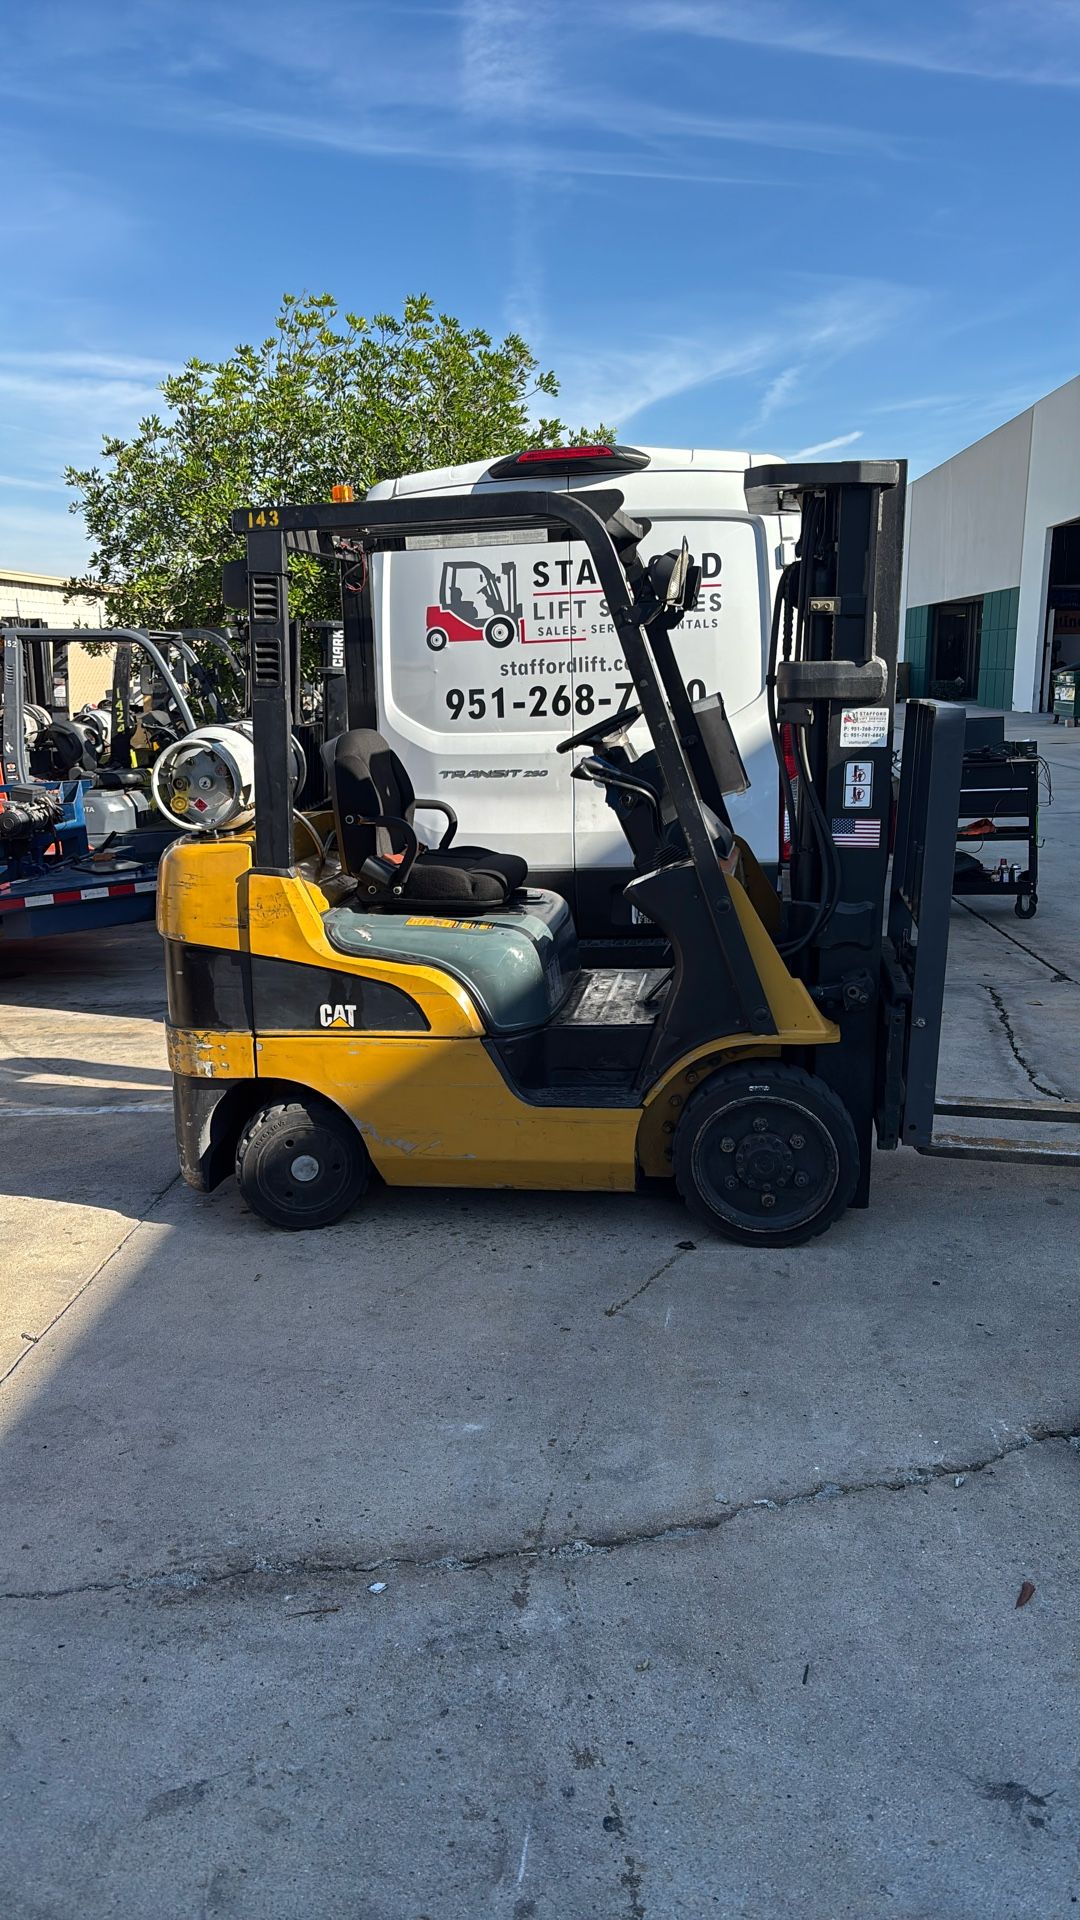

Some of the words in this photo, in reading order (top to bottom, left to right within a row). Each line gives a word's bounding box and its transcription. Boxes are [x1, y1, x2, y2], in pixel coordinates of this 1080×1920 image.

[247, 510, 280, 529] 143
[533, 552, 722, 587] STAD
[533, 600, 587, 621] LIFT
[537, 625, 577, 637] SALES
[332, 629, 344, 668] CLARK
[438, 769, 523, 779] TRANSIT
[319, 1003, 357, 1028] CAT
